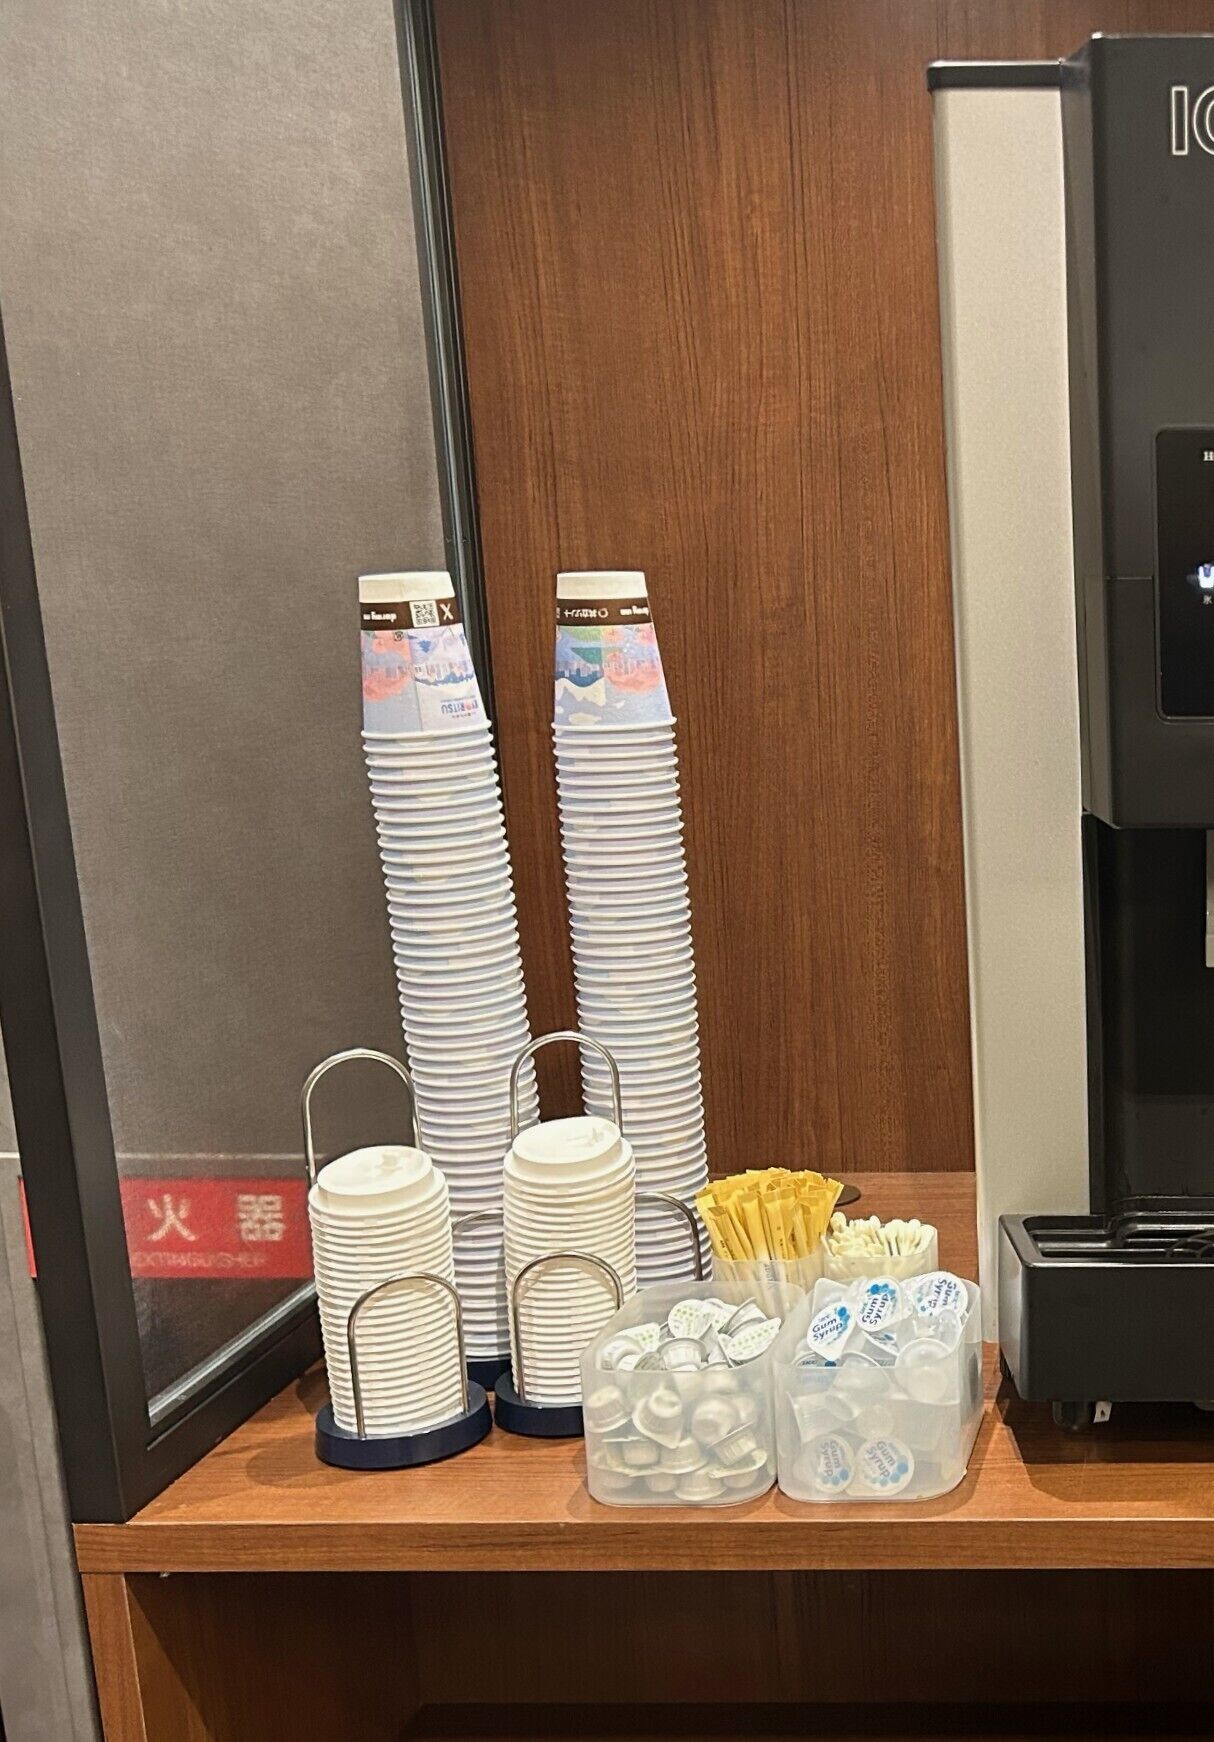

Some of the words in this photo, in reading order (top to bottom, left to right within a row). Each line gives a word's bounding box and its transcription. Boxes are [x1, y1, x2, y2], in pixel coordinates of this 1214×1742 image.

[1203, 595, 1213, 605] 氷
[942, 1281, 957, 1306] Gum
[862, 1298, 879, 1323] Gum
[869, 1293, 889, 1325] Syrup
[812, 1318, 837, 1333] Gum
[813, 1322, 843, 1341] Syrup
[820, 1441, 834, 1478] Syrup
[830, 1440, 841, 1468] Gum
[867, 1446, 891, 1478] Syrup
[876, 1441, 896, 1467] Gum
